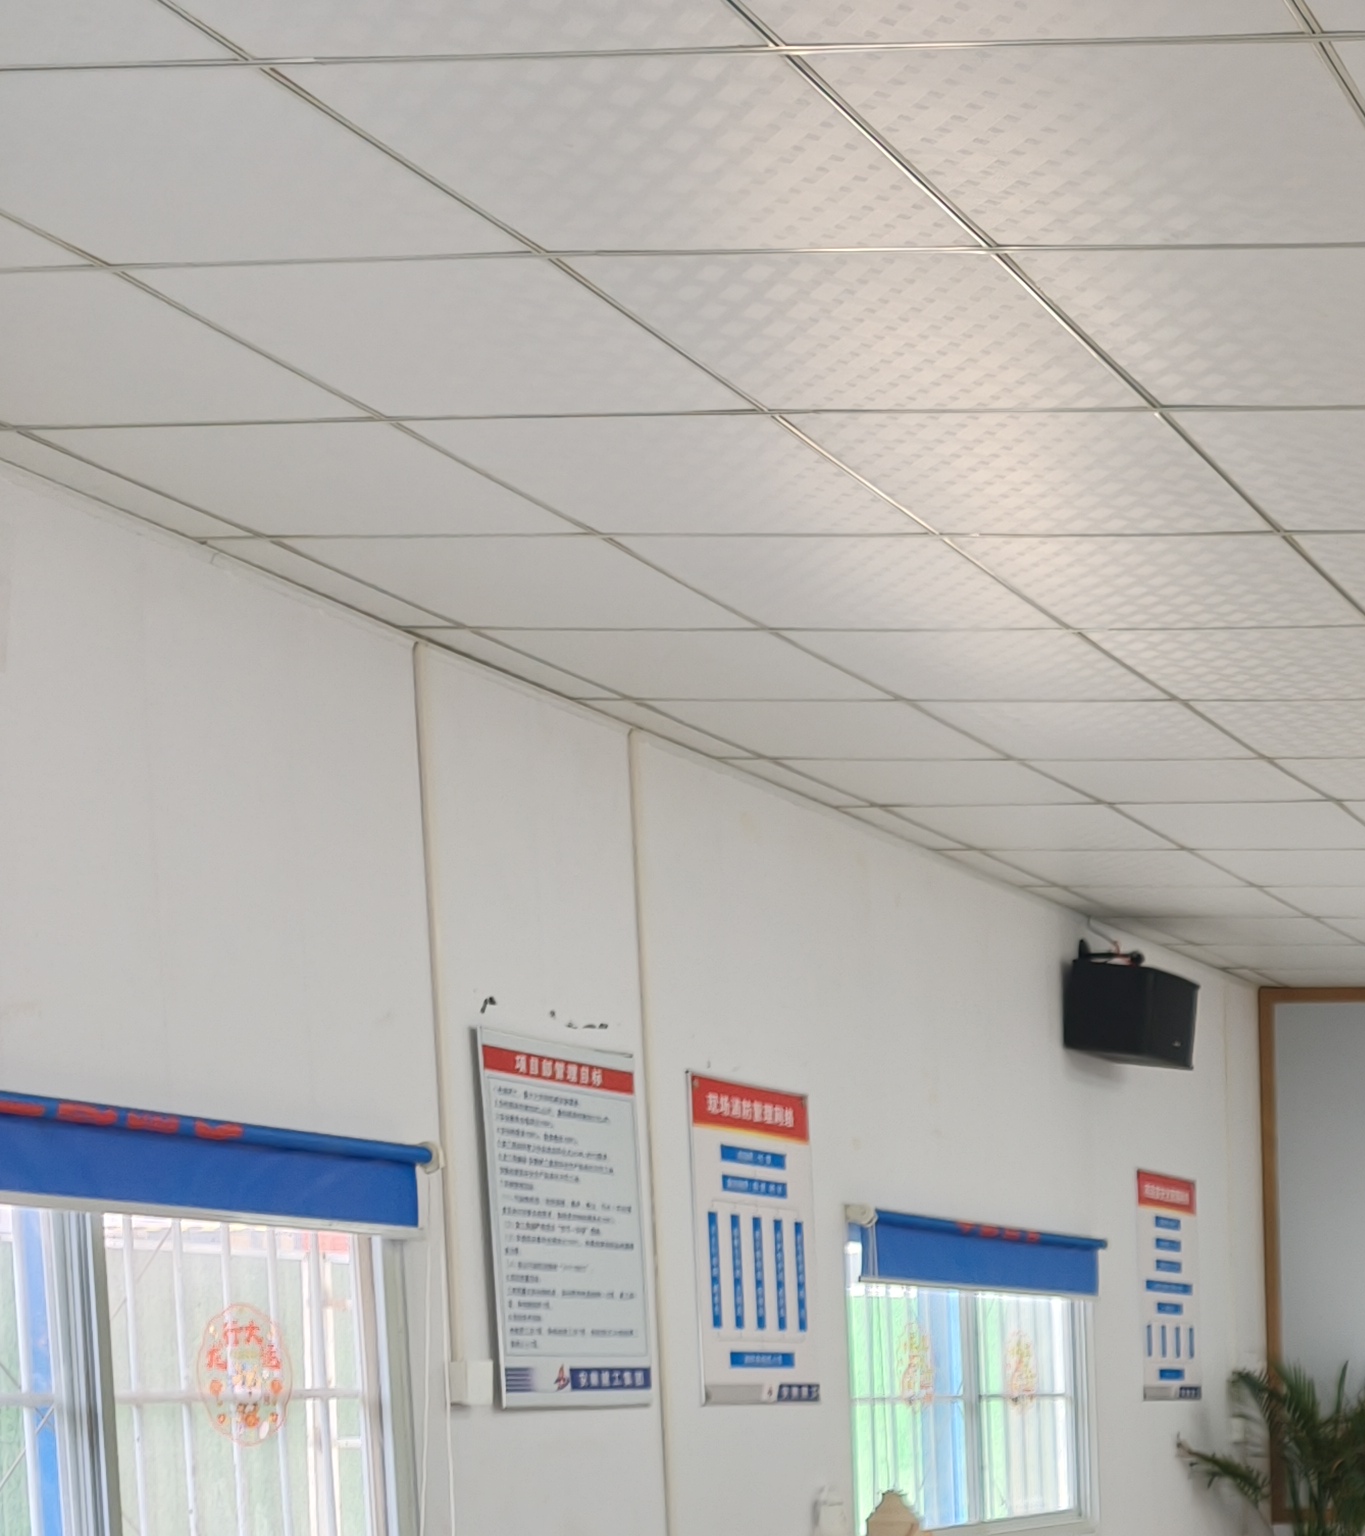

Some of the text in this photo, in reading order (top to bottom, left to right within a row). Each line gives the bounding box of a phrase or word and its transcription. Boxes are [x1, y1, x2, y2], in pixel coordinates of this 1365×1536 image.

[514, 1054, 604, 1088] 项目部管理目标
[705, 1091, 795, 1128] 现场消防管理网络
